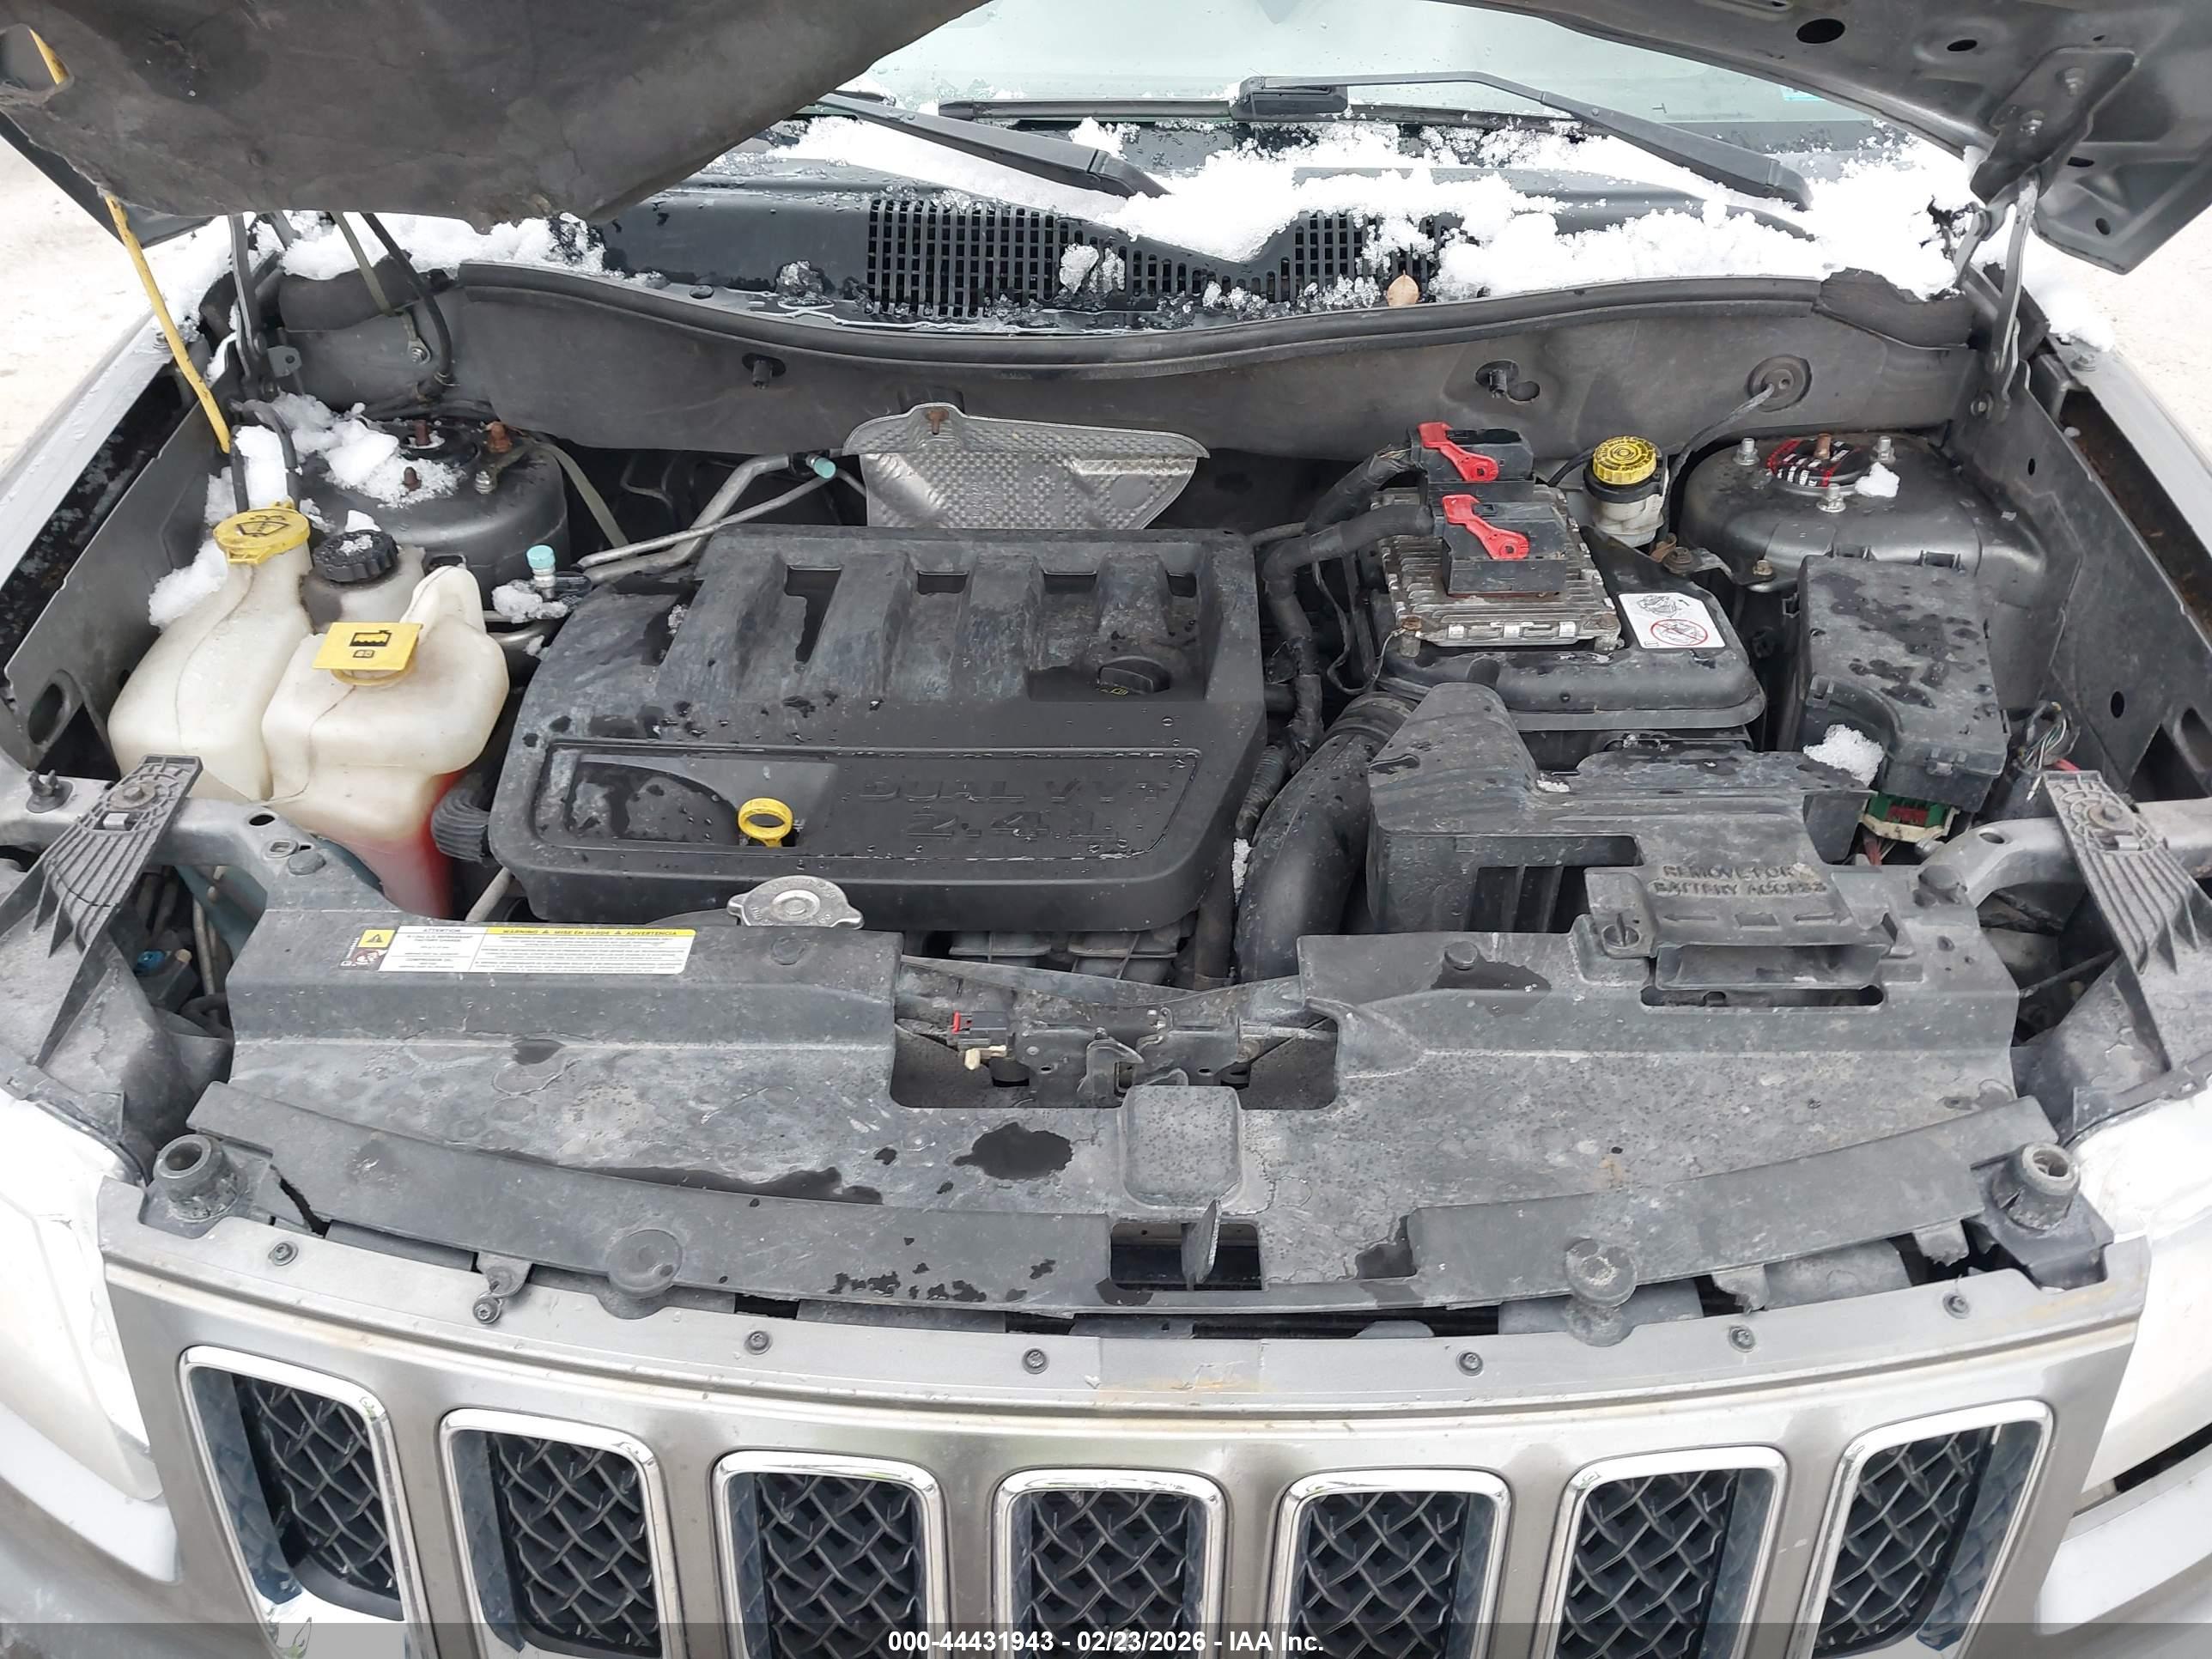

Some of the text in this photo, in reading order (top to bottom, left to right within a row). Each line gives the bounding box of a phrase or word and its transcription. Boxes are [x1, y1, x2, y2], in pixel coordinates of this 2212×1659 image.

[859, 780, 1024, 802] DUAL
[1662, 864, 1751, 879] REMOVE
[1653, 881, 1827, 896] BATTERY ACCESS
